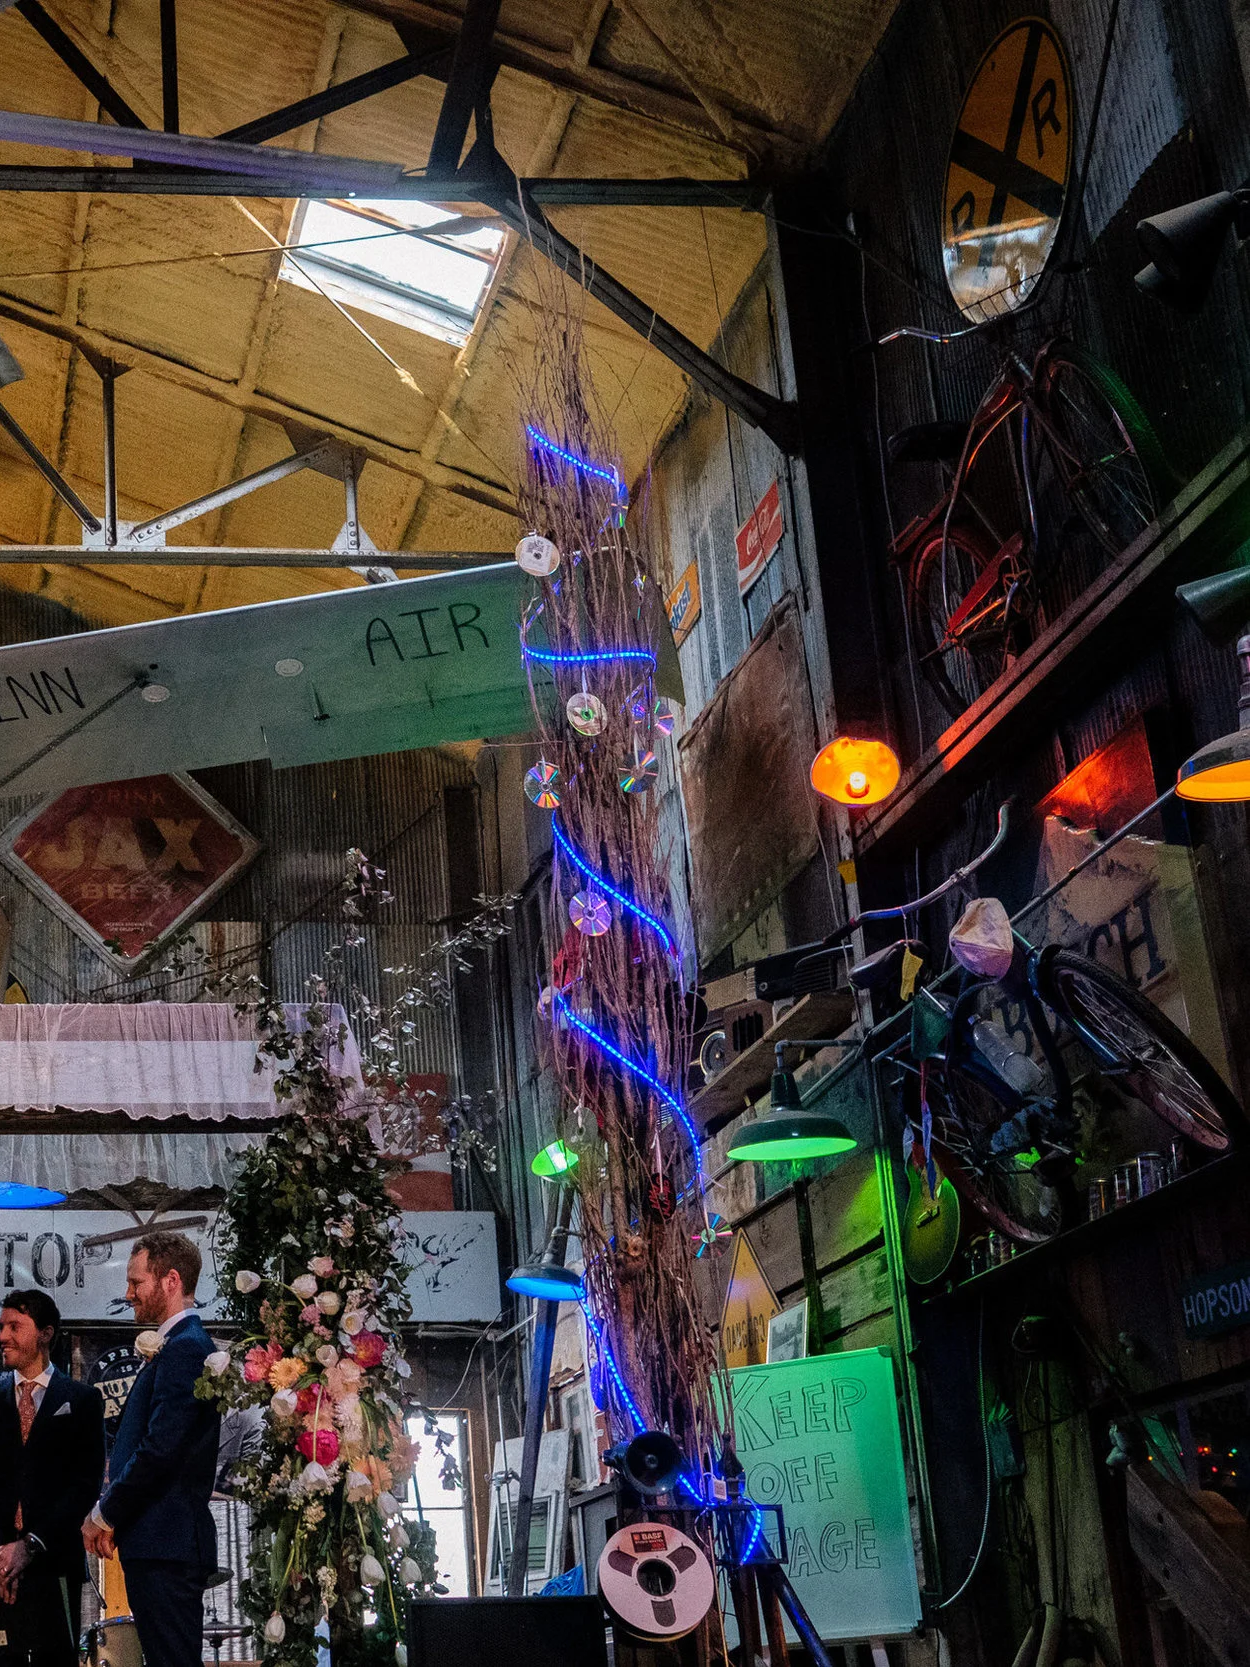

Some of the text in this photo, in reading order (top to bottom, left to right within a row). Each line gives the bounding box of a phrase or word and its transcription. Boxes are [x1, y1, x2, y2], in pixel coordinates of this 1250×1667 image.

[1031, 78, 1062, 160] R
[364, 602, 490, 667] AIR
[32, 814, 206, 871] JAX
[81, 883, 173, 900] BEER
[729, 1374, 867, 1453] KEEP
[748, 1452, 839, 1504] OFF
[763, 1518, 881, 1578] TAGE
